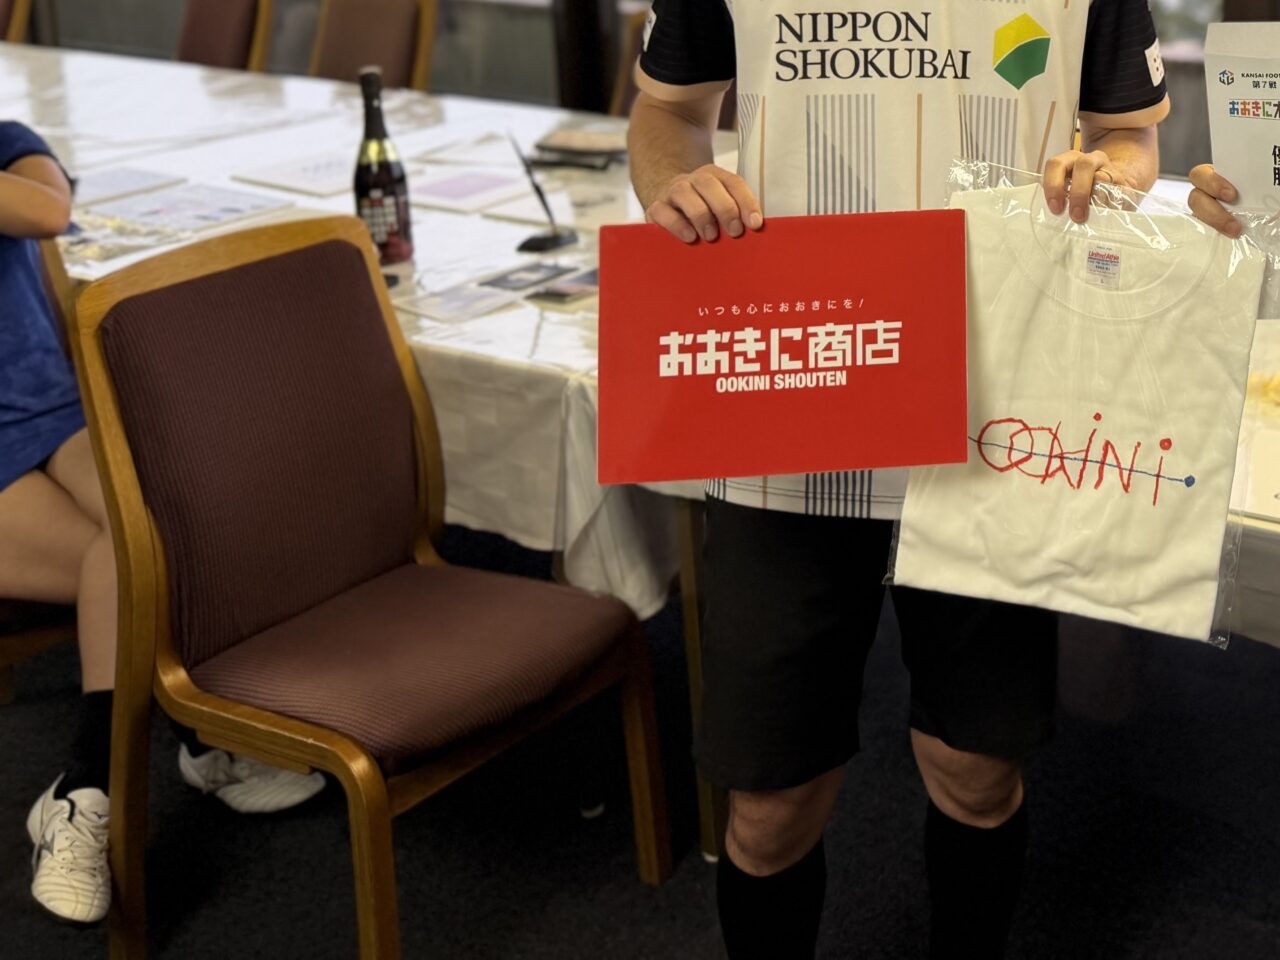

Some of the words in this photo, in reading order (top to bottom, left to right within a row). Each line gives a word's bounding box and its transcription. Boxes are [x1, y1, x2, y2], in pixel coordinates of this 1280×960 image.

[775, 11, 932, 44] NIPPON
[775, 48, 972, 81] SHOKUBAI
[659, 320, 902, 377] おおきに商店
[715, 373, 770, 393] OOKINI
[774, 370, 847, 391] SHOUTEN
